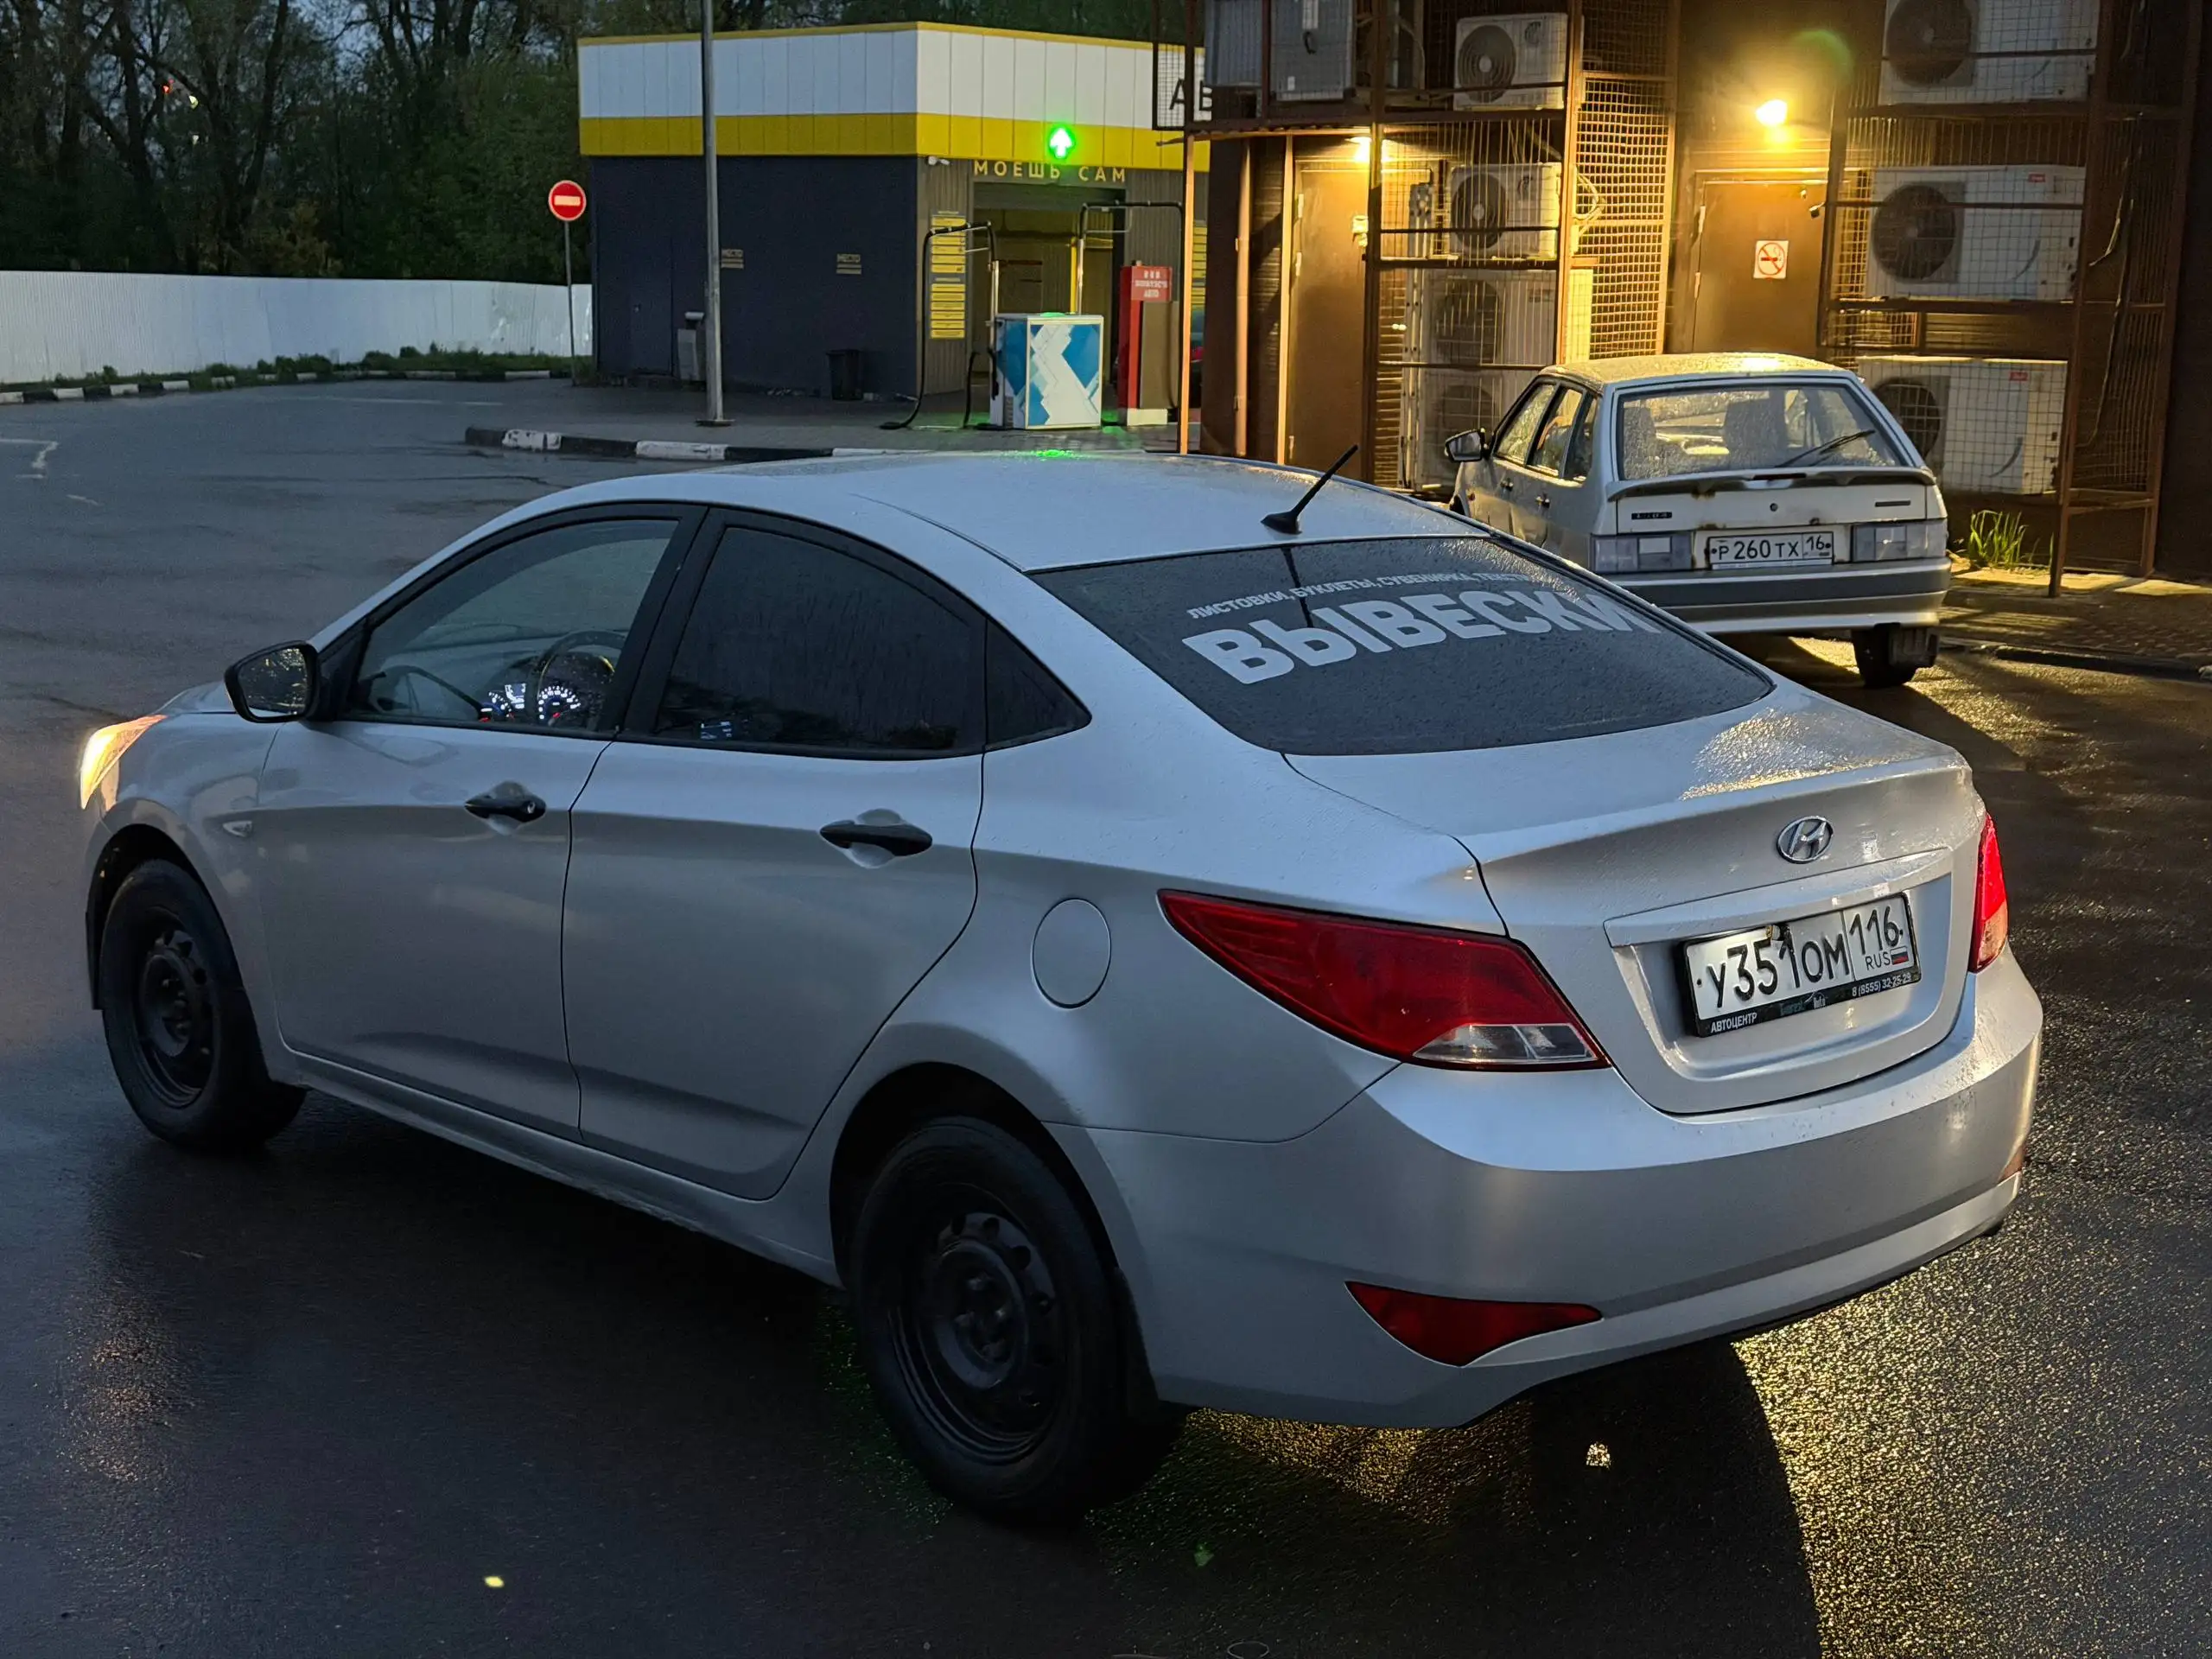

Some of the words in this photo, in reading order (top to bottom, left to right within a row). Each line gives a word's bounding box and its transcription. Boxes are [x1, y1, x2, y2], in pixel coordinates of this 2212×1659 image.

[974, 161, 1061, 179] МОЕШЬ
[1077, 166, 1126, 182] САМ
[1806, 535, 1825, 550] 16
[1181, 590, 1662, 684] ВЫВЕСКИ
[1848, 906, 1900, 956] 116
[1866, 952, 1891, 970] RUS
[1711, 1012, 1758, 1033] АВТОЦЕНТР
